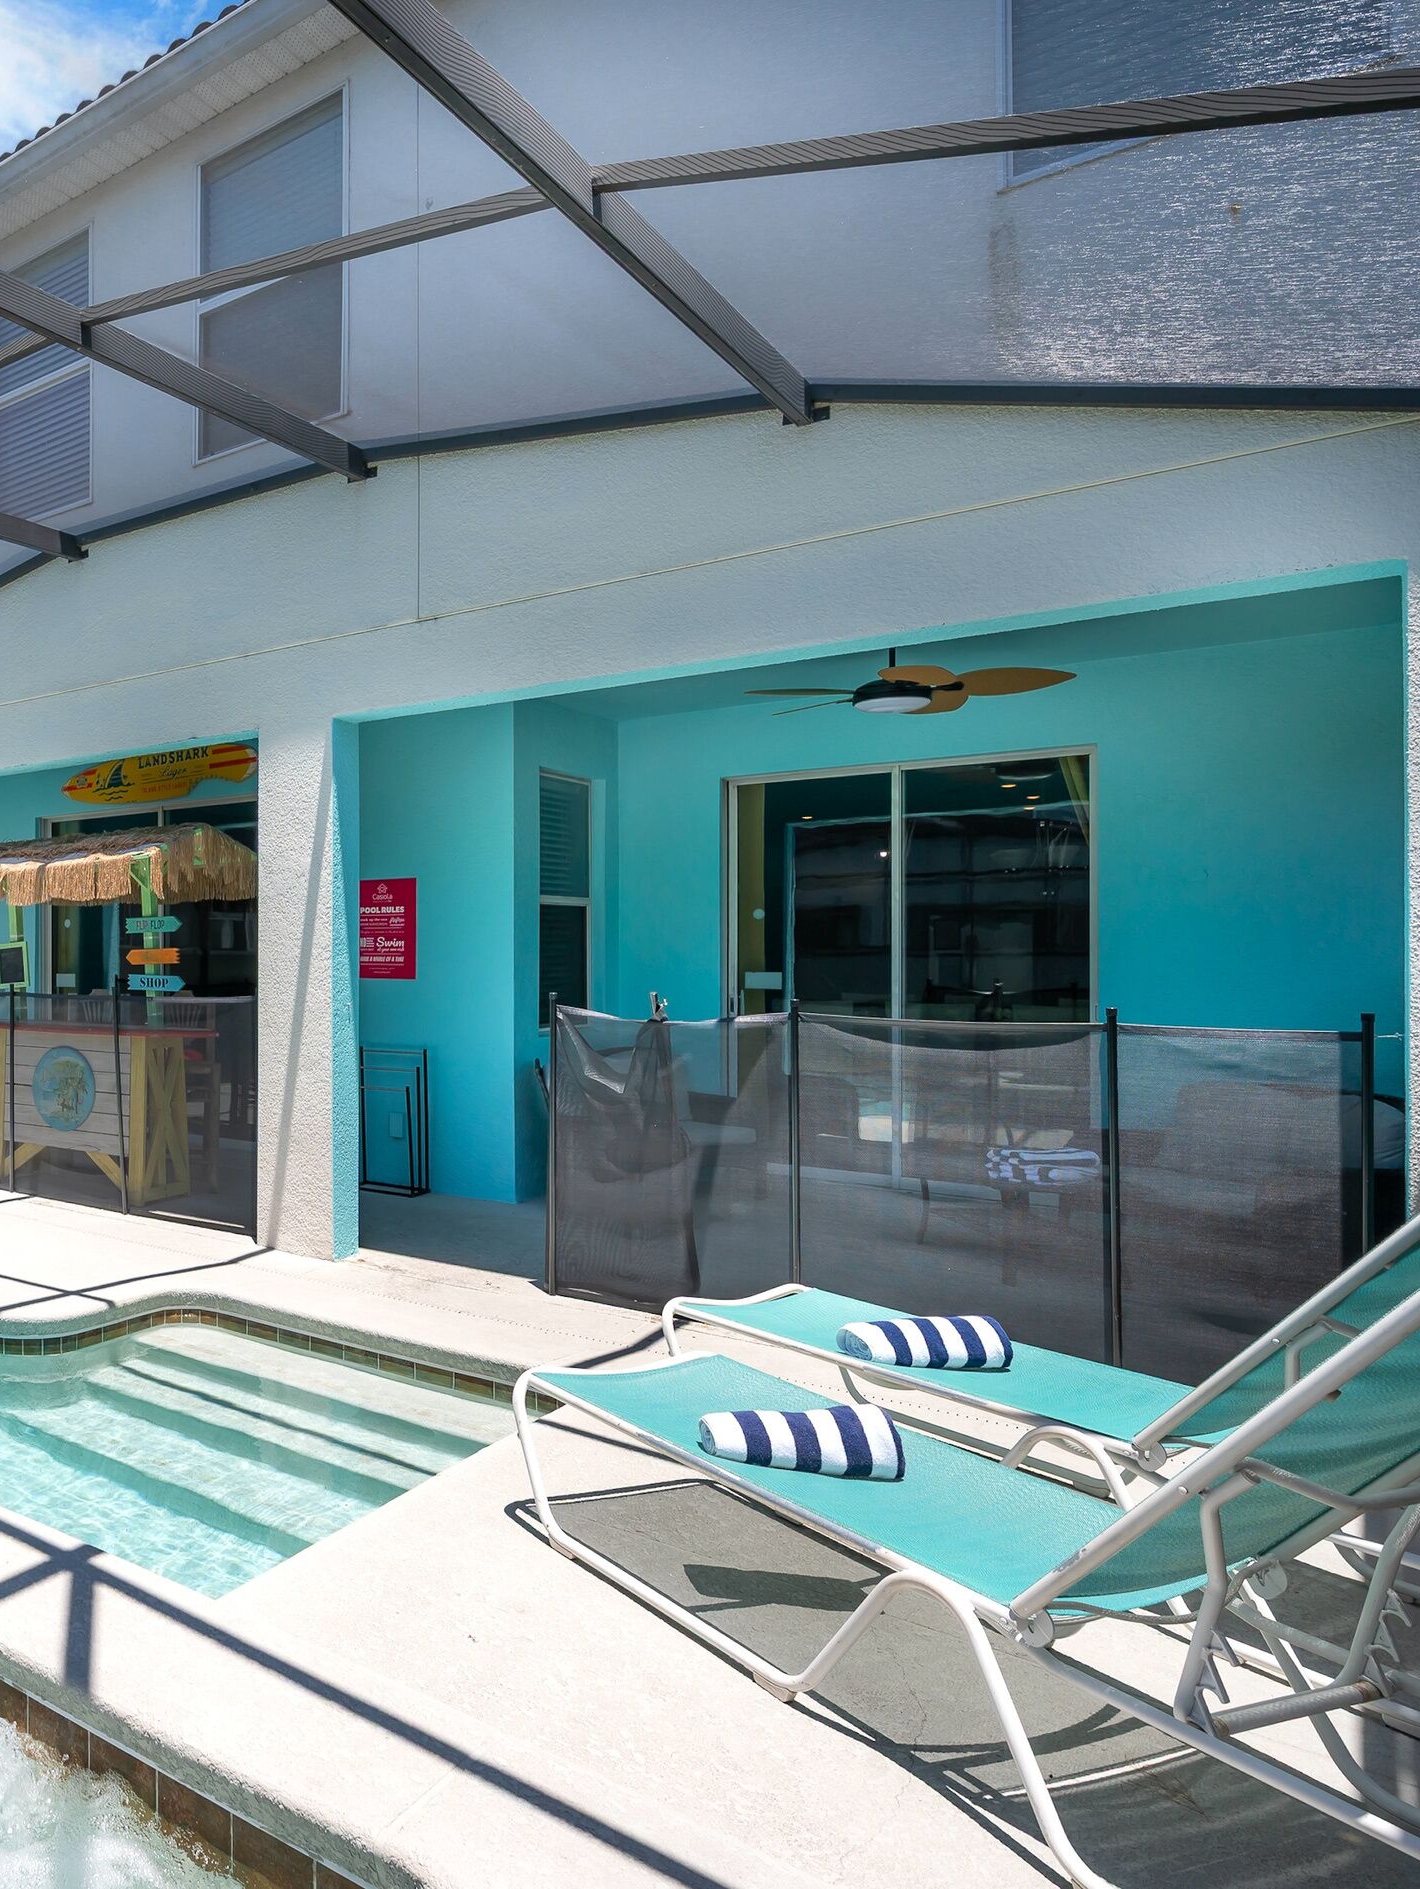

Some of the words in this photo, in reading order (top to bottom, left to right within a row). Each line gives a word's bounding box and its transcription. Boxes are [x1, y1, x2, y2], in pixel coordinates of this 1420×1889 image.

[138, 746, 209, 769] LANDSHARK
[360, 906, 380, 914] POOL
[381, 906, 405, 914] RULES
[376, 936, 405, 948] Swim
[140, 978, 169, 988] SHOP
